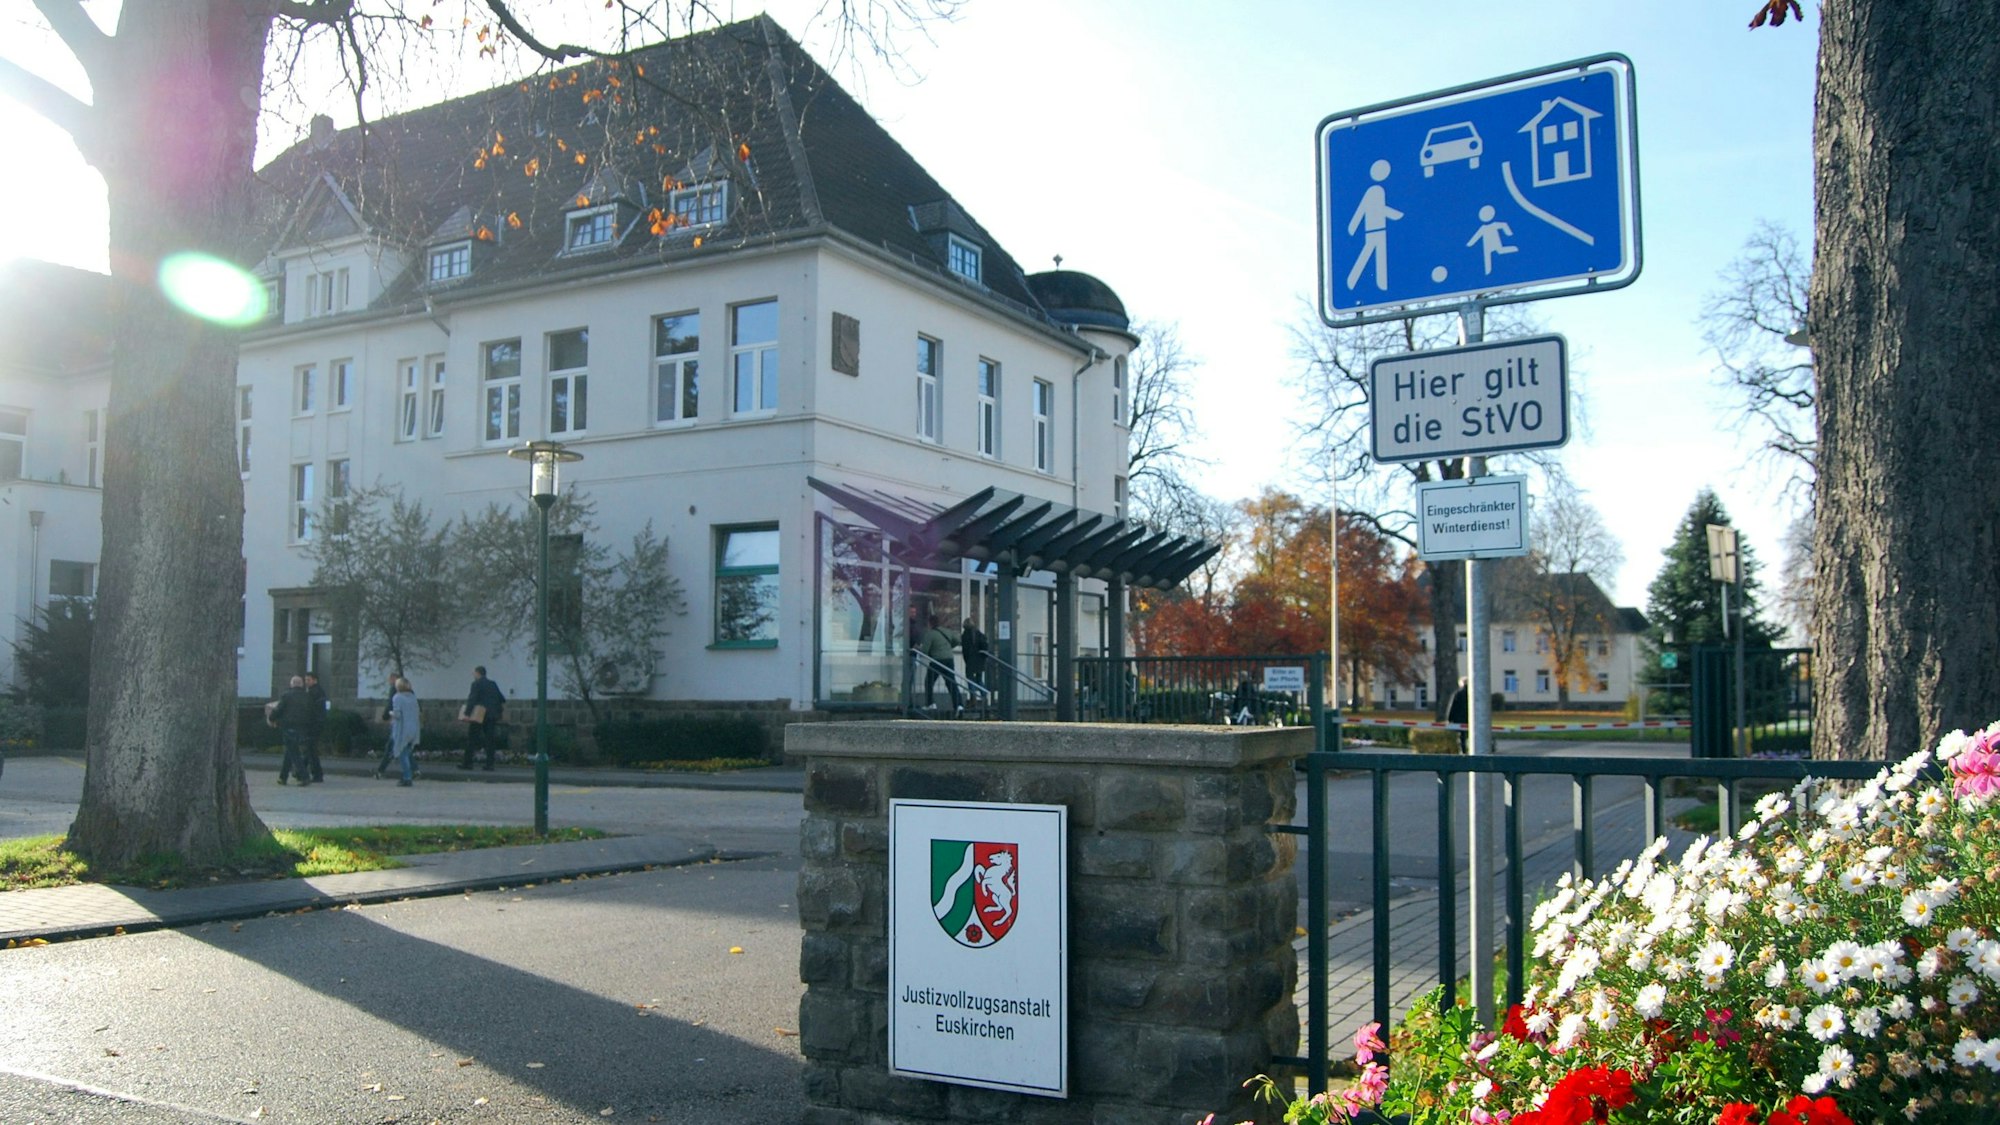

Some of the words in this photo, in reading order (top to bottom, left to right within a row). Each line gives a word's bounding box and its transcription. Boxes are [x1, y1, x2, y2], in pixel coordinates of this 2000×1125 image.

[1394, 369, 1465, 402] Hier
[1485, 357, 1539, 399] gilt
[1394, 412, 1443, 444] die
[1462, 400, 1542, 437] StVO
[1427, 500, 1516, 518] Eingeschränkter
[1432, 518, 1511, 534] Winterdienst!
[902, 985, 1051, 1018] Justizvollzugsanstalt
[936, 1014, 1014, 1041] Euskirchen
